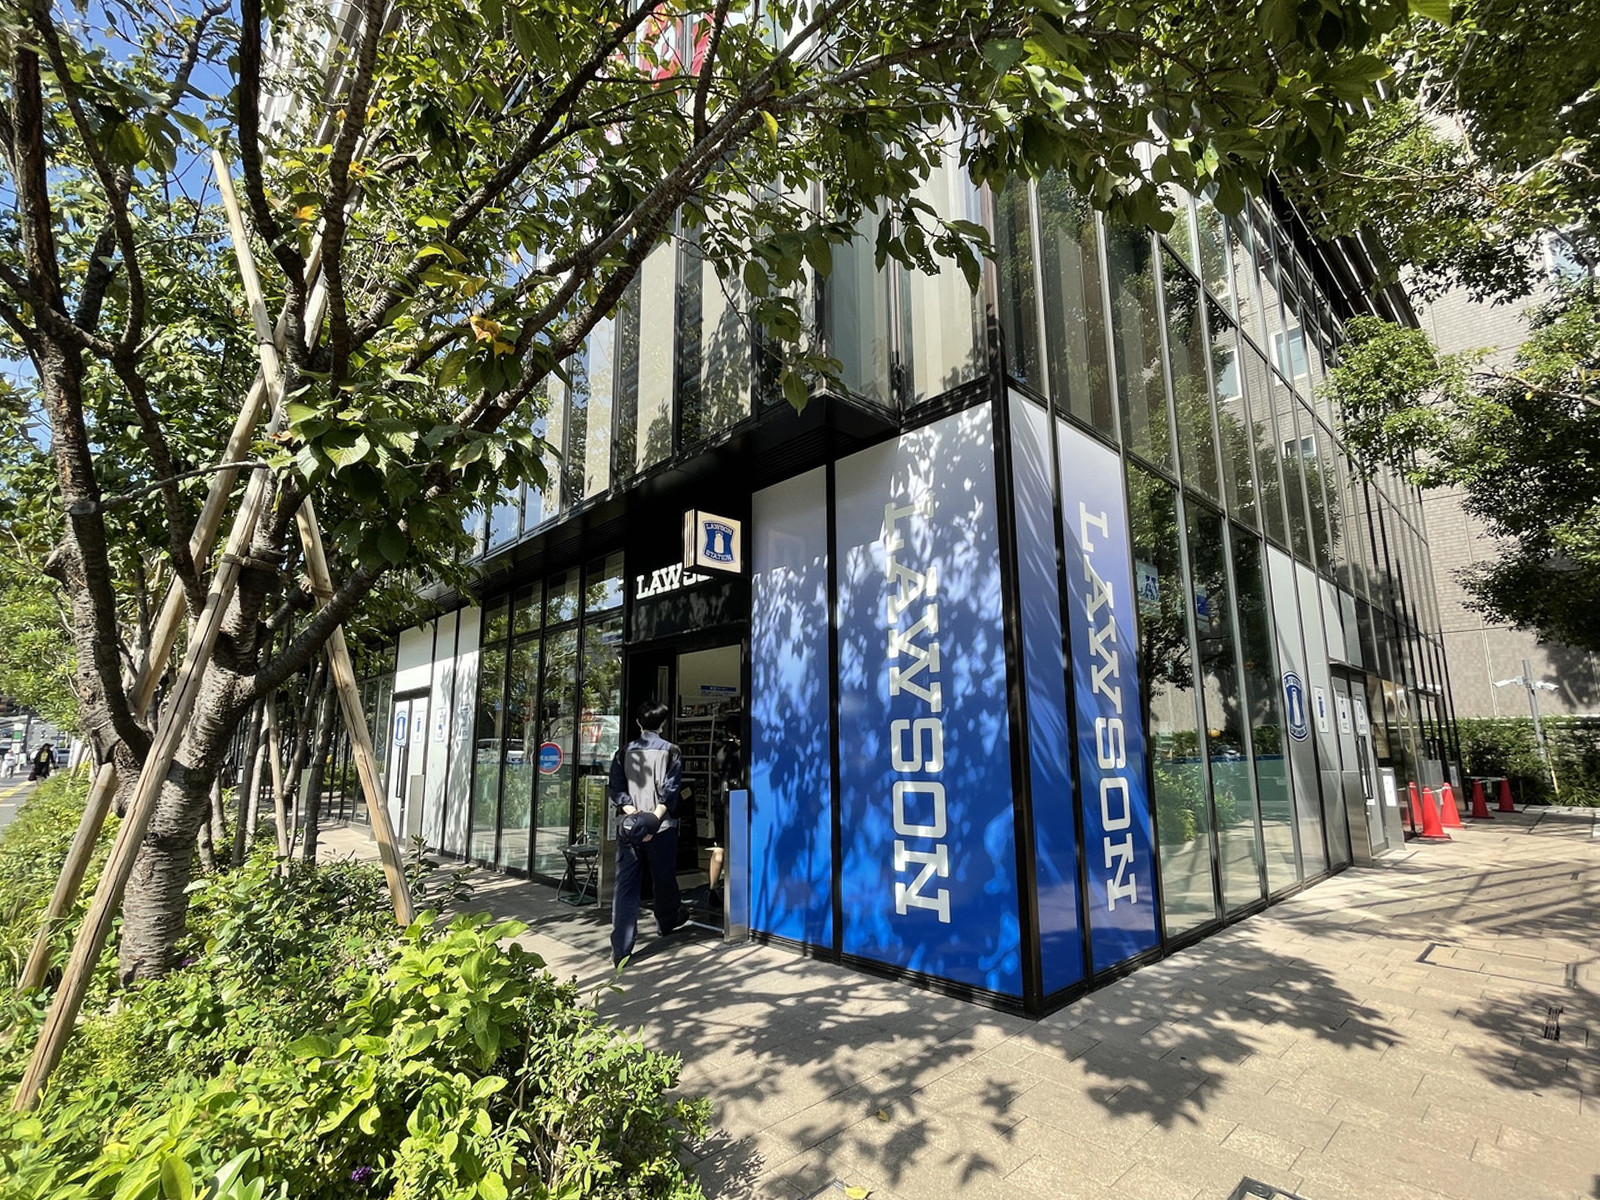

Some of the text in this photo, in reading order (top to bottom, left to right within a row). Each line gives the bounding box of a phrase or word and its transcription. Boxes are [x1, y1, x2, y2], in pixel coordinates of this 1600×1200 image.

[636, 562, 713, 599] LAWS
[885, 489, 951, 923] LAWSON
[1080, 501, 1137, 911] LAWSON
